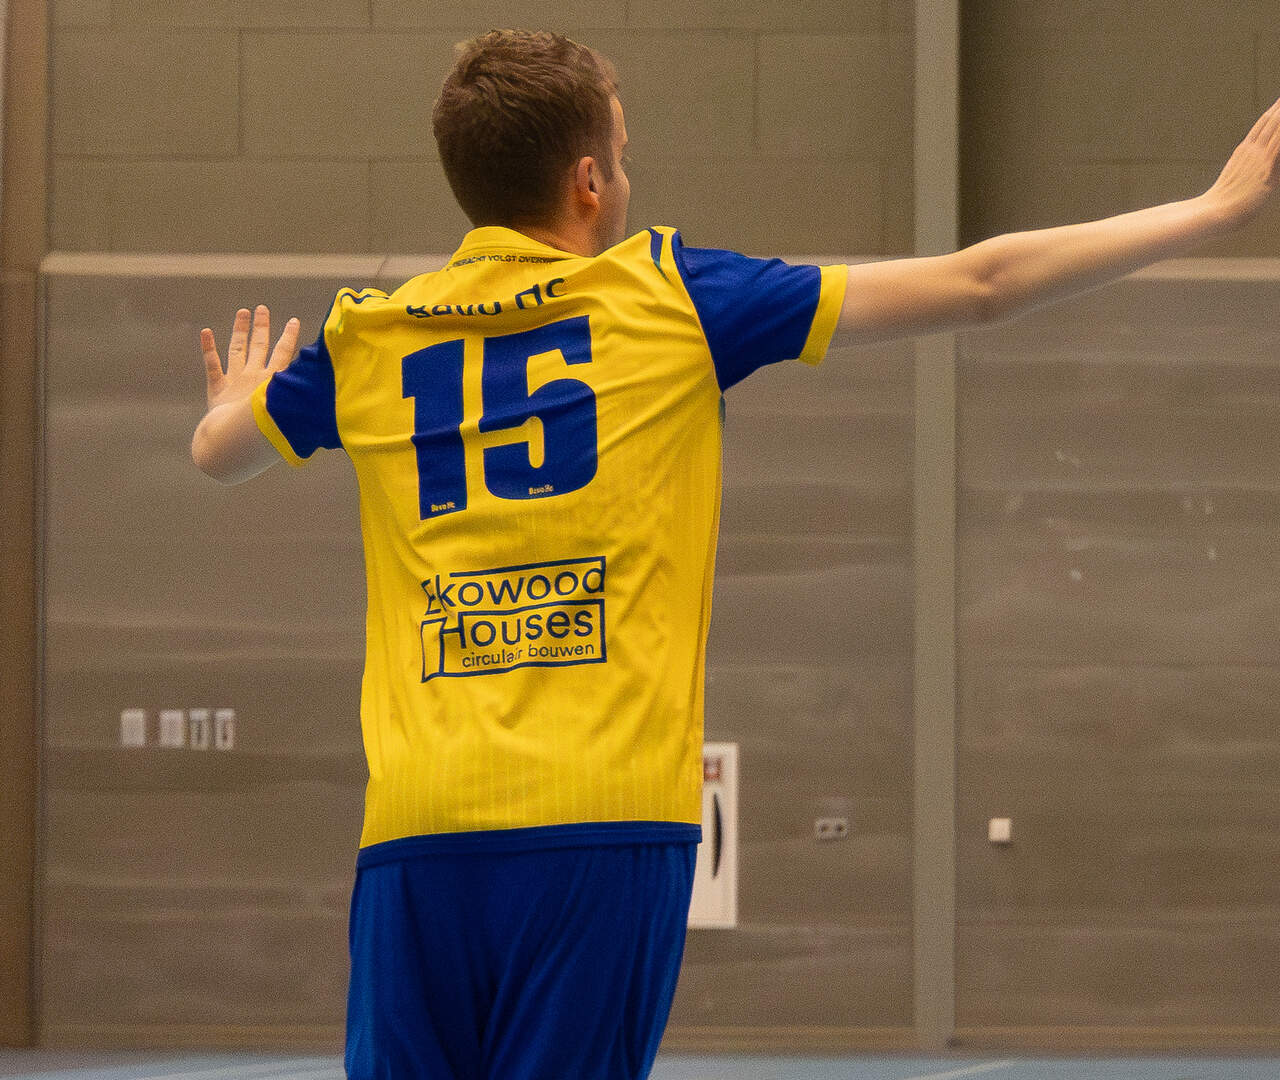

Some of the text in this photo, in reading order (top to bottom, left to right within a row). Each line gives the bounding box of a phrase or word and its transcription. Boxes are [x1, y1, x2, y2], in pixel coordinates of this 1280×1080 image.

[401, 315, 598, 521] 15
[420, 566, 605, 616] Ekowood
[439, 609, 594, 649] Houses
[462, 643, 595, 668] circulair bouwen
